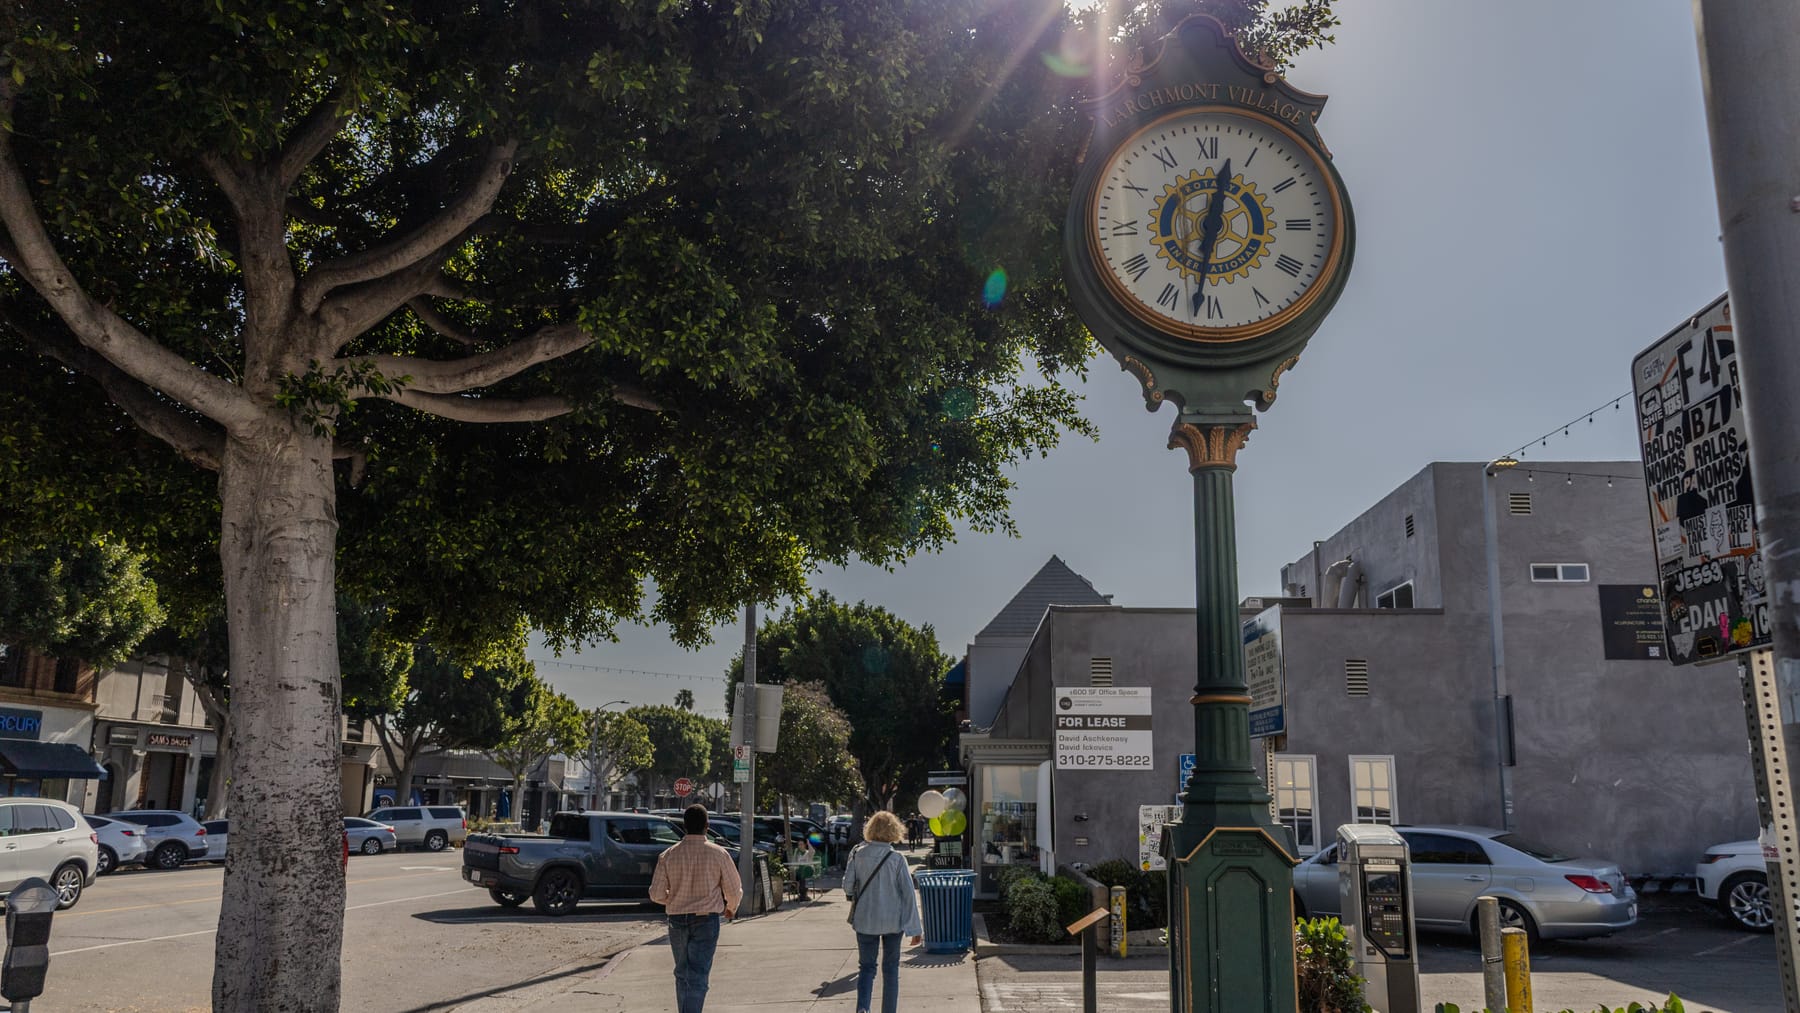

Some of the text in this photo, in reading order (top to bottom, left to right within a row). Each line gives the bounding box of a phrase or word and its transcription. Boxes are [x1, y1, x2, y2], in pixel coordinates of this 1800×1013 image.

[1101, 83, 1306, 129] LARCHMONT VILLAGE
[1183, 180, 1236, 194] ROTAY
[1168, 243, 1258, 274] INERATIONAL
[1646, 450, 1686, 487] NOMAS
[1695, 452, 1742, 492] NOMAS
[1707, 480, 1736, 507] MTA
[1058, 717, 1127, 728] FOR LEASE
[1059, 743, 1081, 751] David
[1059, 754, 1151, 766] 310-275-8222
[675, 783, 692, 792] STOP
